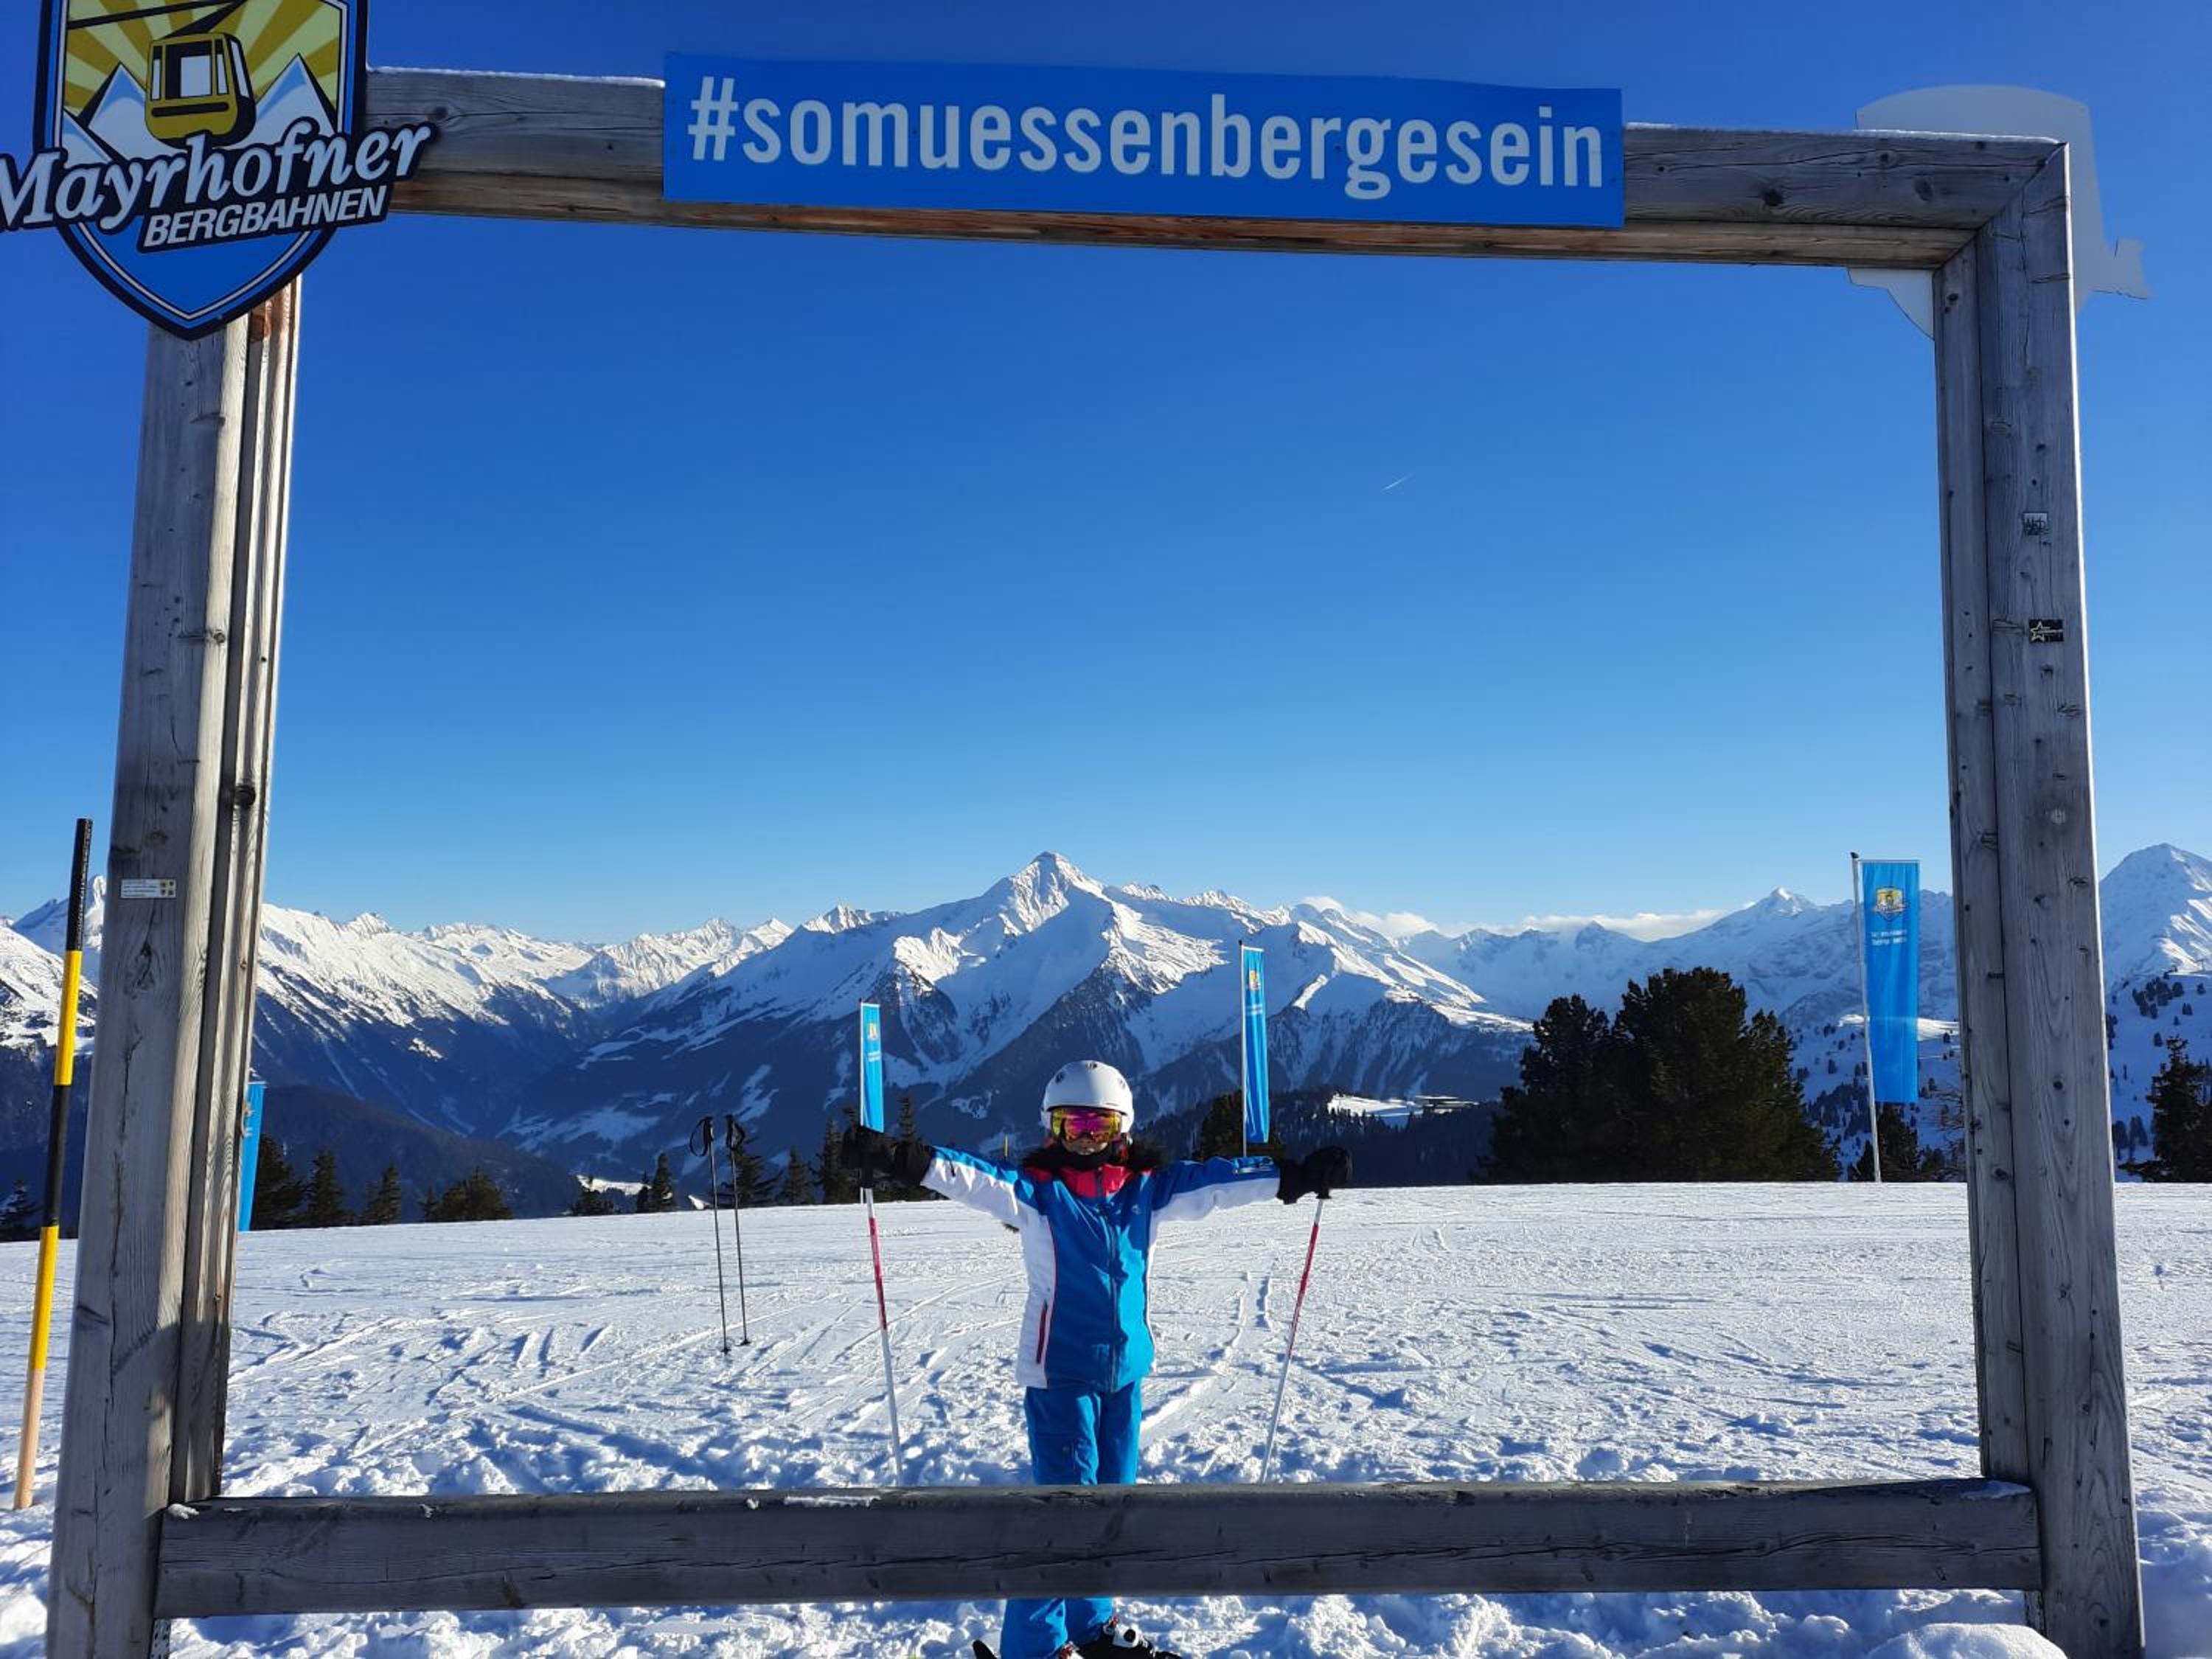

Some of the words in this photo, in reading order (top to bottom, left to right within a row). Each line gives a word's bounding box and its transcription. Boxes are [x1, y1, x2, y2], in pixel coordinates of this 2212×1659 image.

[0, 121, 431, 230] Mayrhofner
[687, 76, 1603, 200] #somuessenbergesein
[144, 185, 387, 248] BERGBAHNEN
